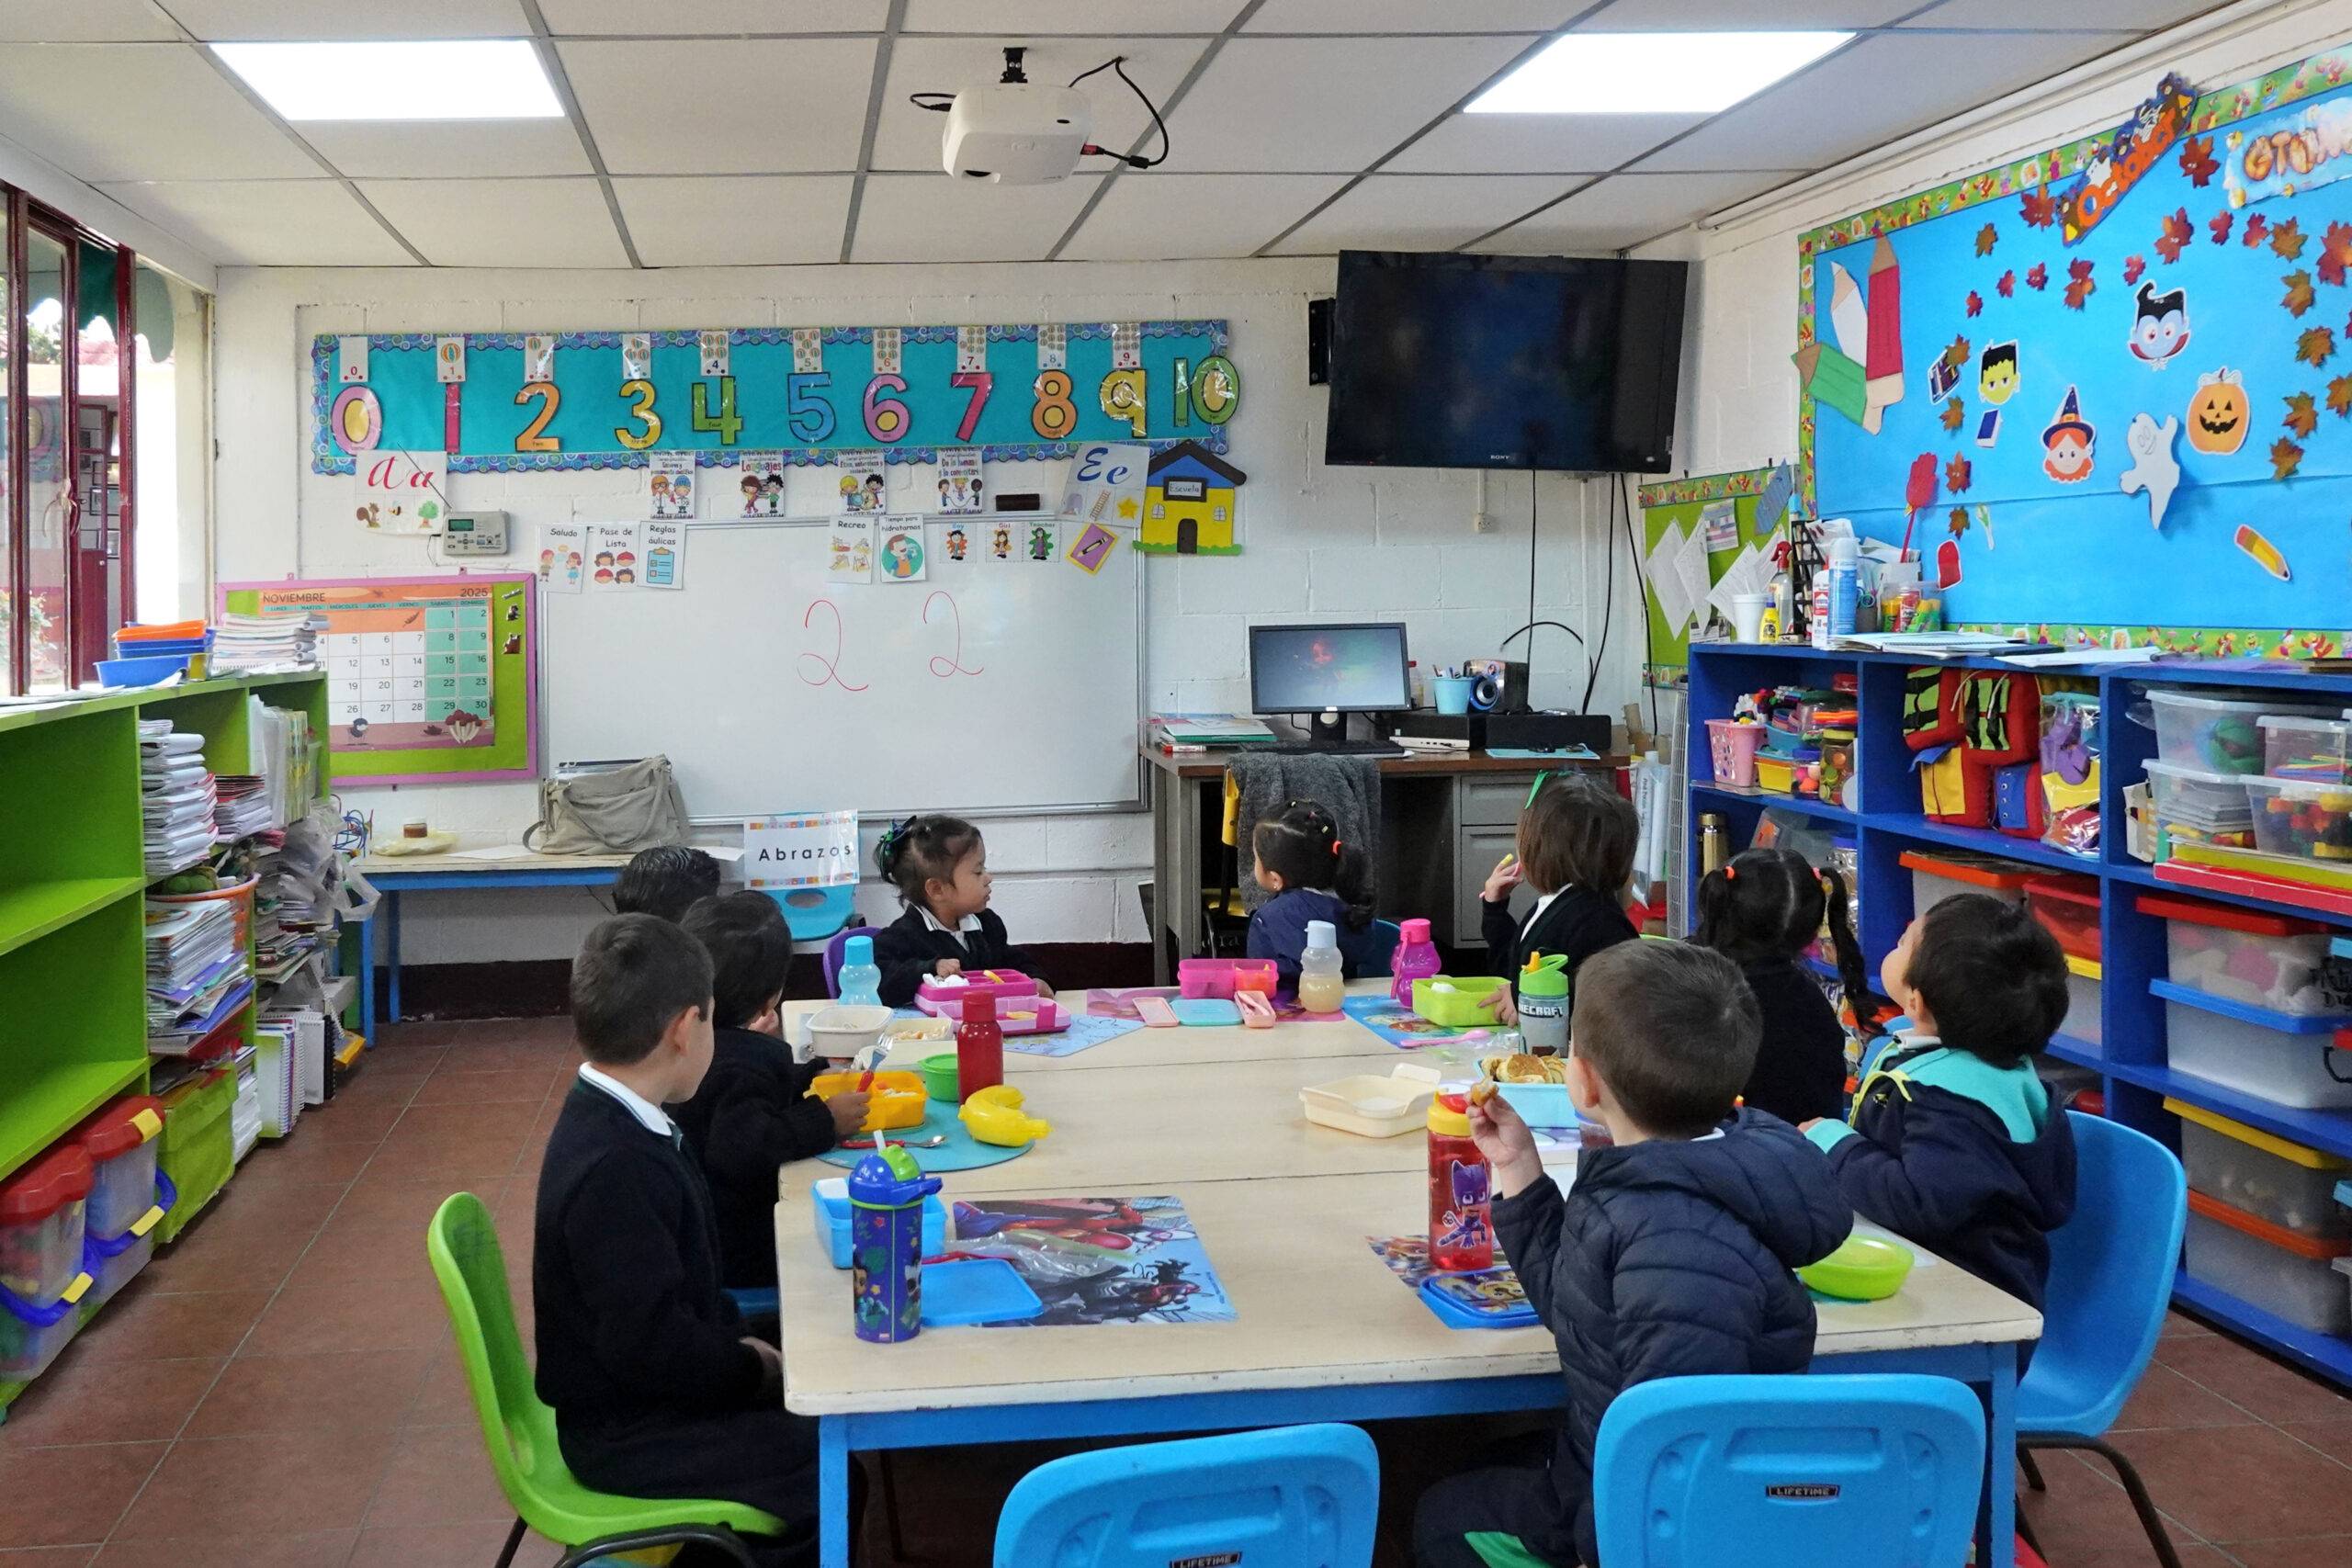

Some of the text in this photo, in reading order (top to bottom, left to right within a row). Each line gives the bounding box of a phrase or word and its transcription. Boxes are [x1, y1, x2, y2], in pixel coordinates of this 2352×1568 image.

[883, 357, 891, 367] 6
[967, 355, 975, 366] 7
[1049, 353, 1057, 364] 8
[1123, 352, 1130, 362] 9
[712, 359, 719, 369] 4
[804, 358, 811, 367] 5
[445, 381, 461, 454] 1
[514, 380, 561, 452] 2
[615, 378, 662, 450] 3
[692, 376, 743, 446] 4
[787, 372, 837, 443] 5
[862, 373, 911, 443] 6
[950, 372, 993, 443] 7
[1032, 369, 1078, 439] 8
[1173, 355, 1240, 428] 10
[741, 460, 782, 475] Lenguajes
[1169, 483, 1200, 494] Escuela
[650, 525, 676, 535] Reglas
[838, 521, 866, 529] Recreo
[881, 524, 921, 532] hidratarnos
[550, 527, 578, 537] Saludo
[600, 527, 633, 536] Pase de
[605, 539, 627, 547] Lista
[648, 536, 676, 546] áulicas
[263, 587, 489, 604] NOVIEMBRE 2025
[448, 633, 455, 641] 8
[481, 632, 487, 640] 9
[797, 590, 985, 692] 2 2
[349, 660, 357, 668] 12
[446, 656, 455, 664] 15
[478, 655, 487, 663] 16
[348, 678, 487, 691] 19 20 21 22 23
[346, 701, 487, 714] 26 27 28 29 30
[758, 845, 852, 862] Abrazos
[1519, 1003, 1564, 1017] NECRAFT
[1776, 1487, 1830, 1495] LIFETIME
